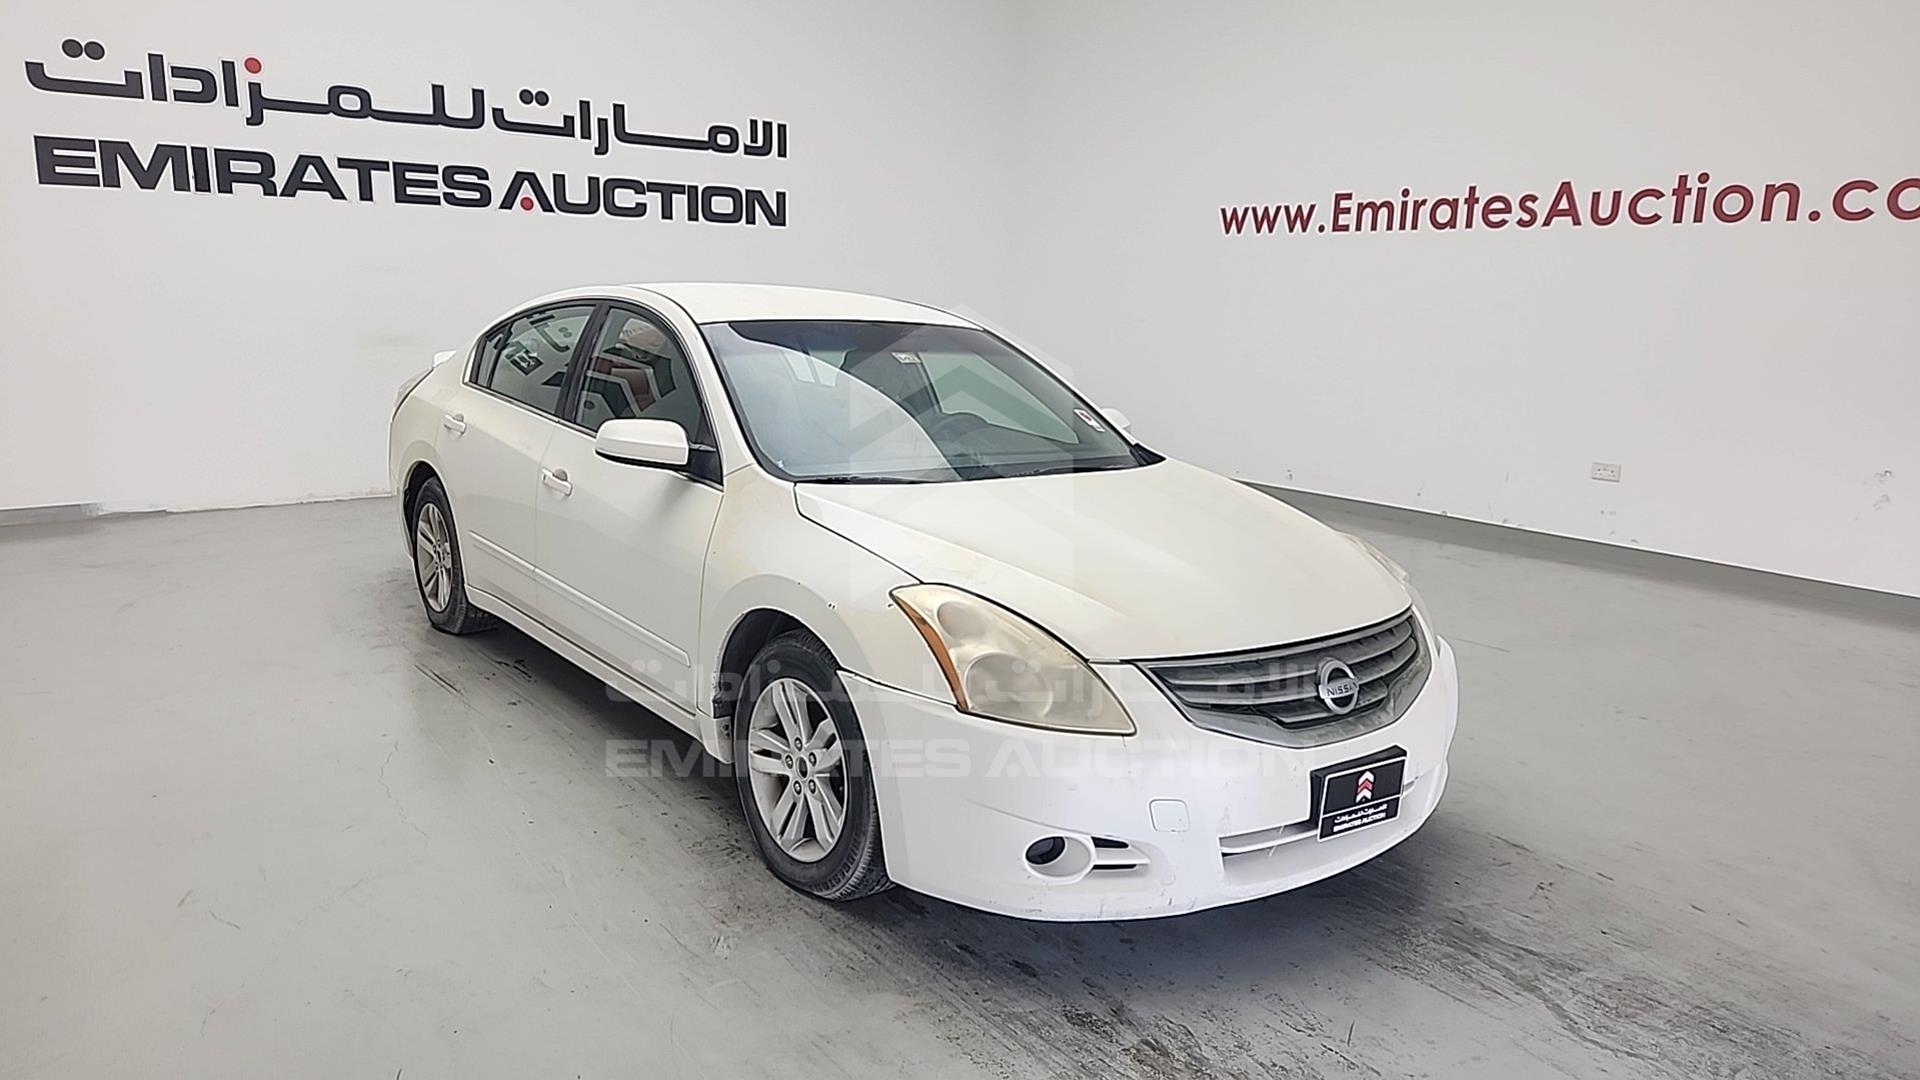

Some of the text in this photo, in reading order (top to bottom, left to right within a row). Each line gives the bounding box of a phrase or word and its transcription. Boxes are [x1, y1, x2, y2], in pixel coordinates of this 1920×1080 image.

[24, 38, 788, 158] الامارات للمزادات
[33, 134, 788, 227] EMIRATES AUCTION
